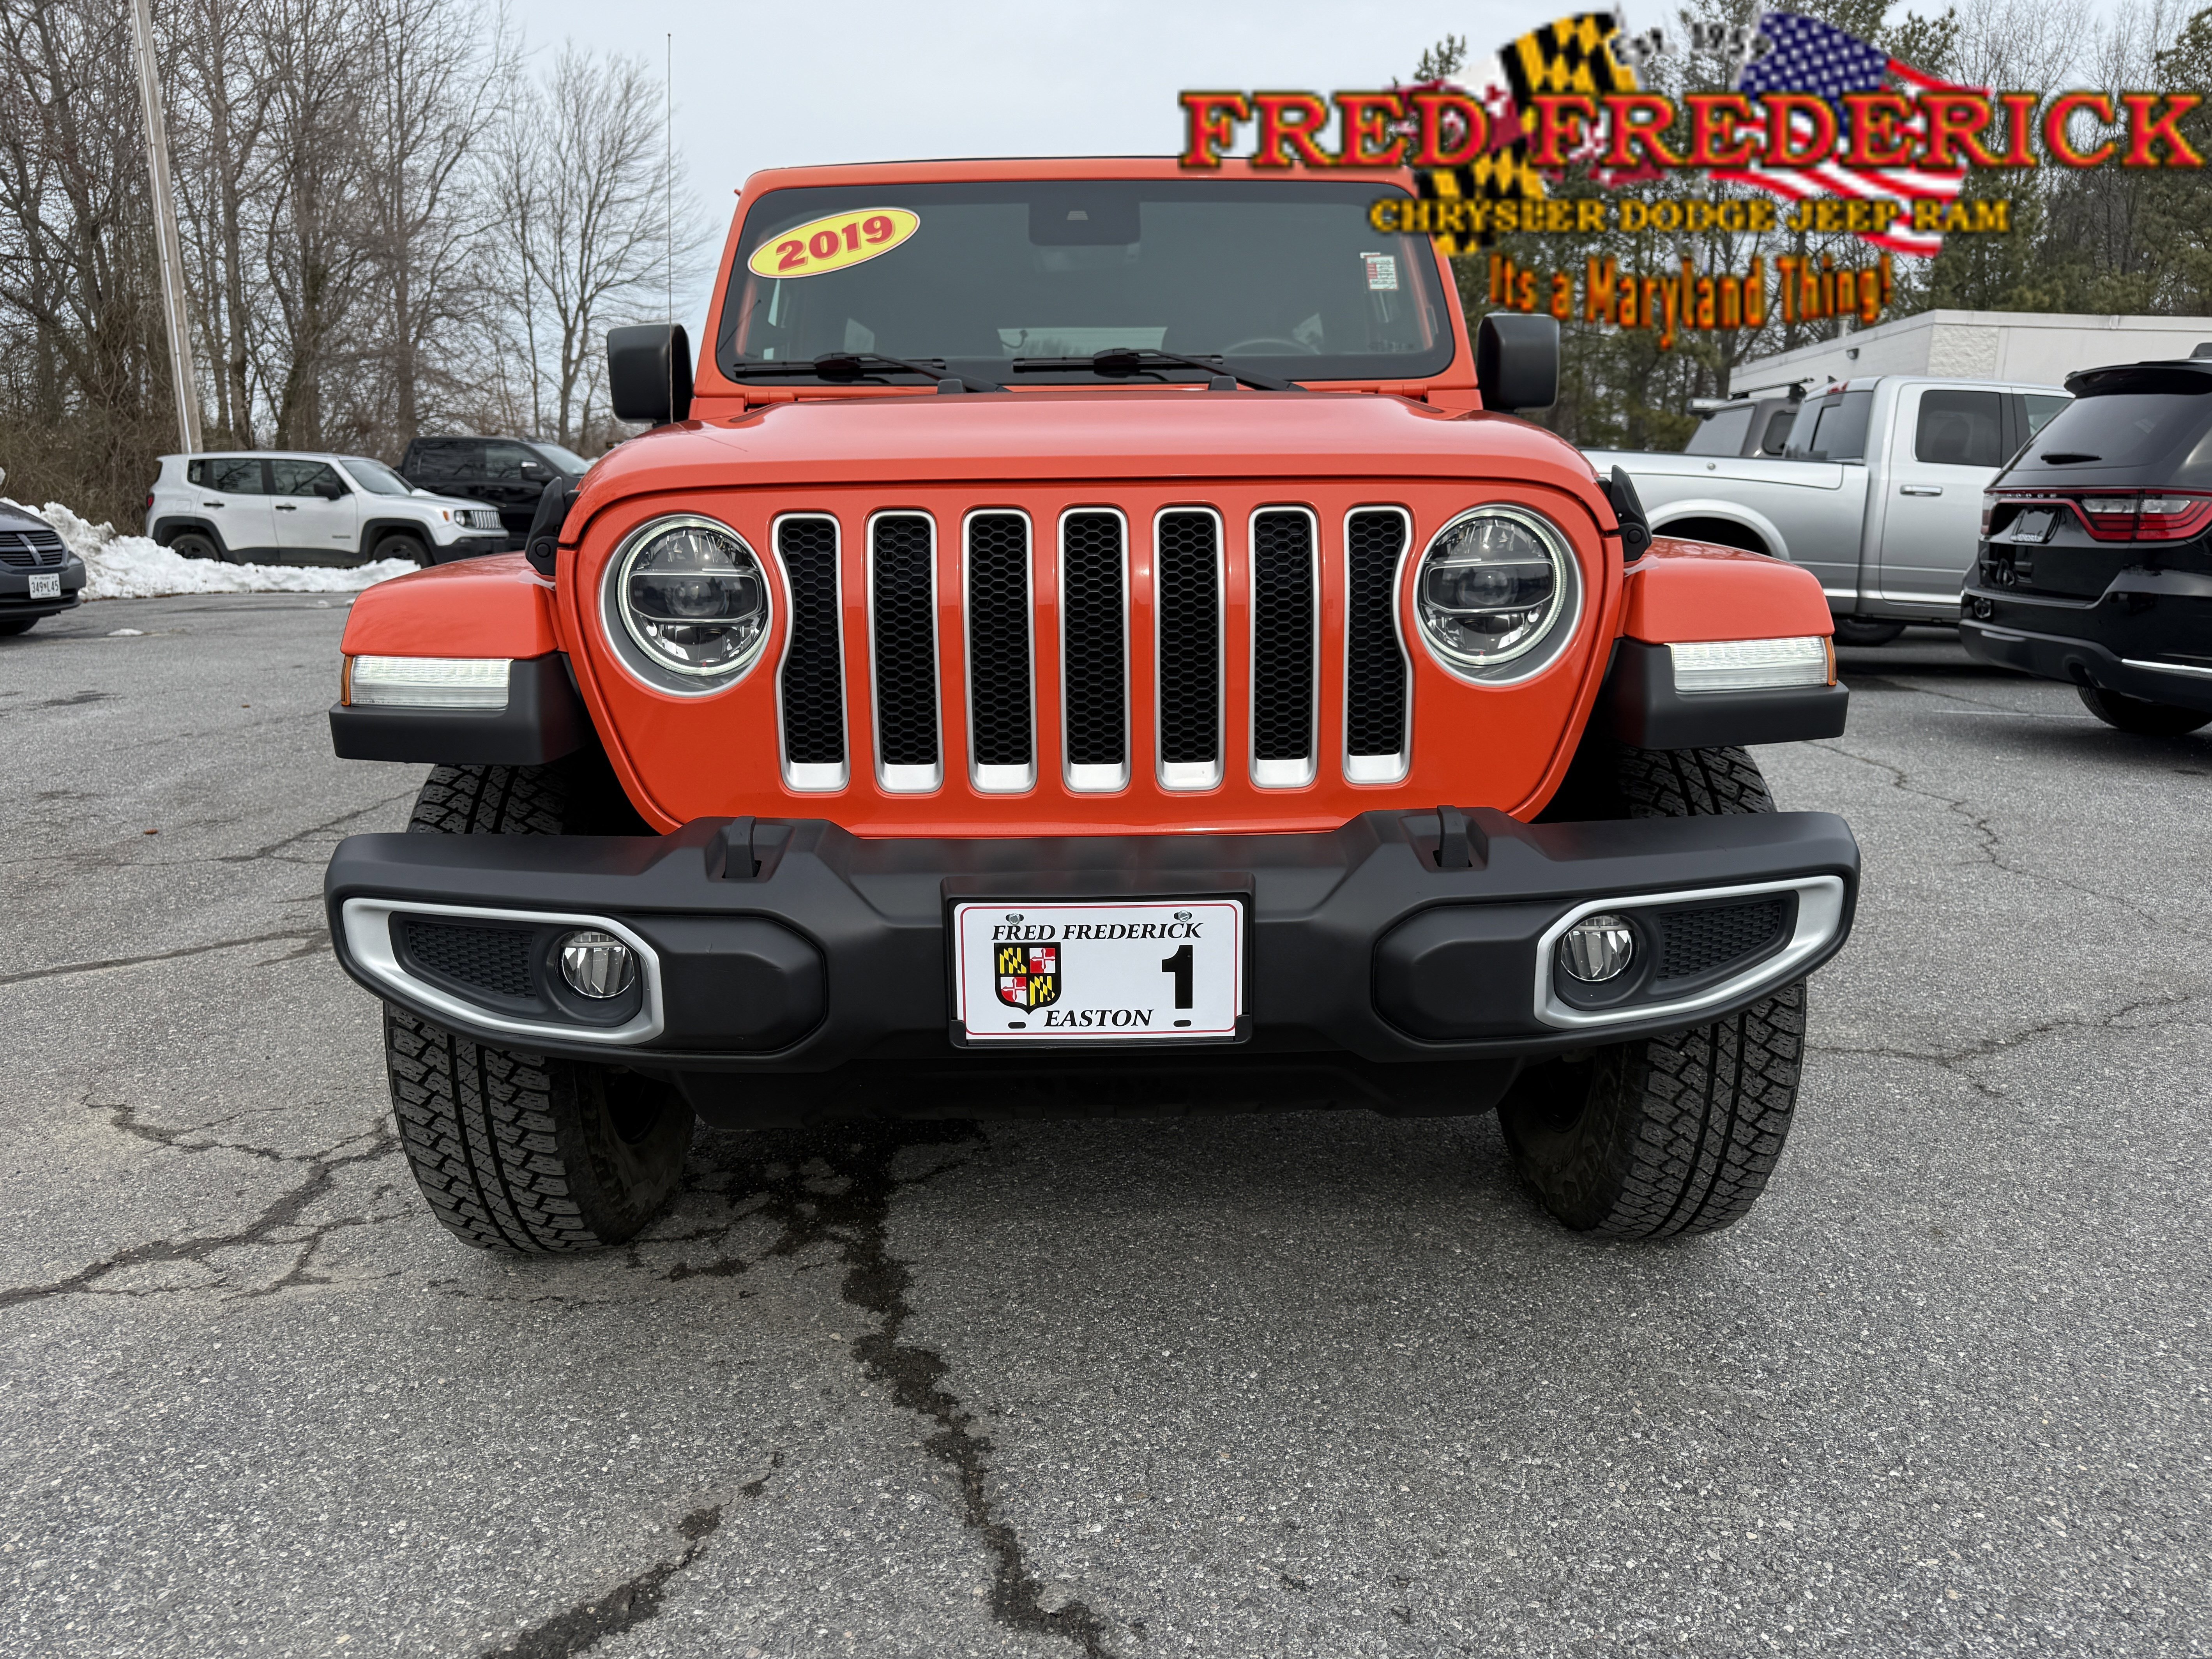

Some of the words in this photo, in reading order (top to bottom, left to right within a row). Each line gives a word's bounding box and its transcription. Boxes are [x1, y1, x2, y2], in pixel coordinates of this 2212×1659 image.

[776, 216, 896, 272] 2019
[991, 924, 1056, 941] FRED
[1062, 922, 1204, 940] FREDERICK
[1161, 945, 1193, 1009] 1
[1044, 1009, 1154, 1027] EASTON
